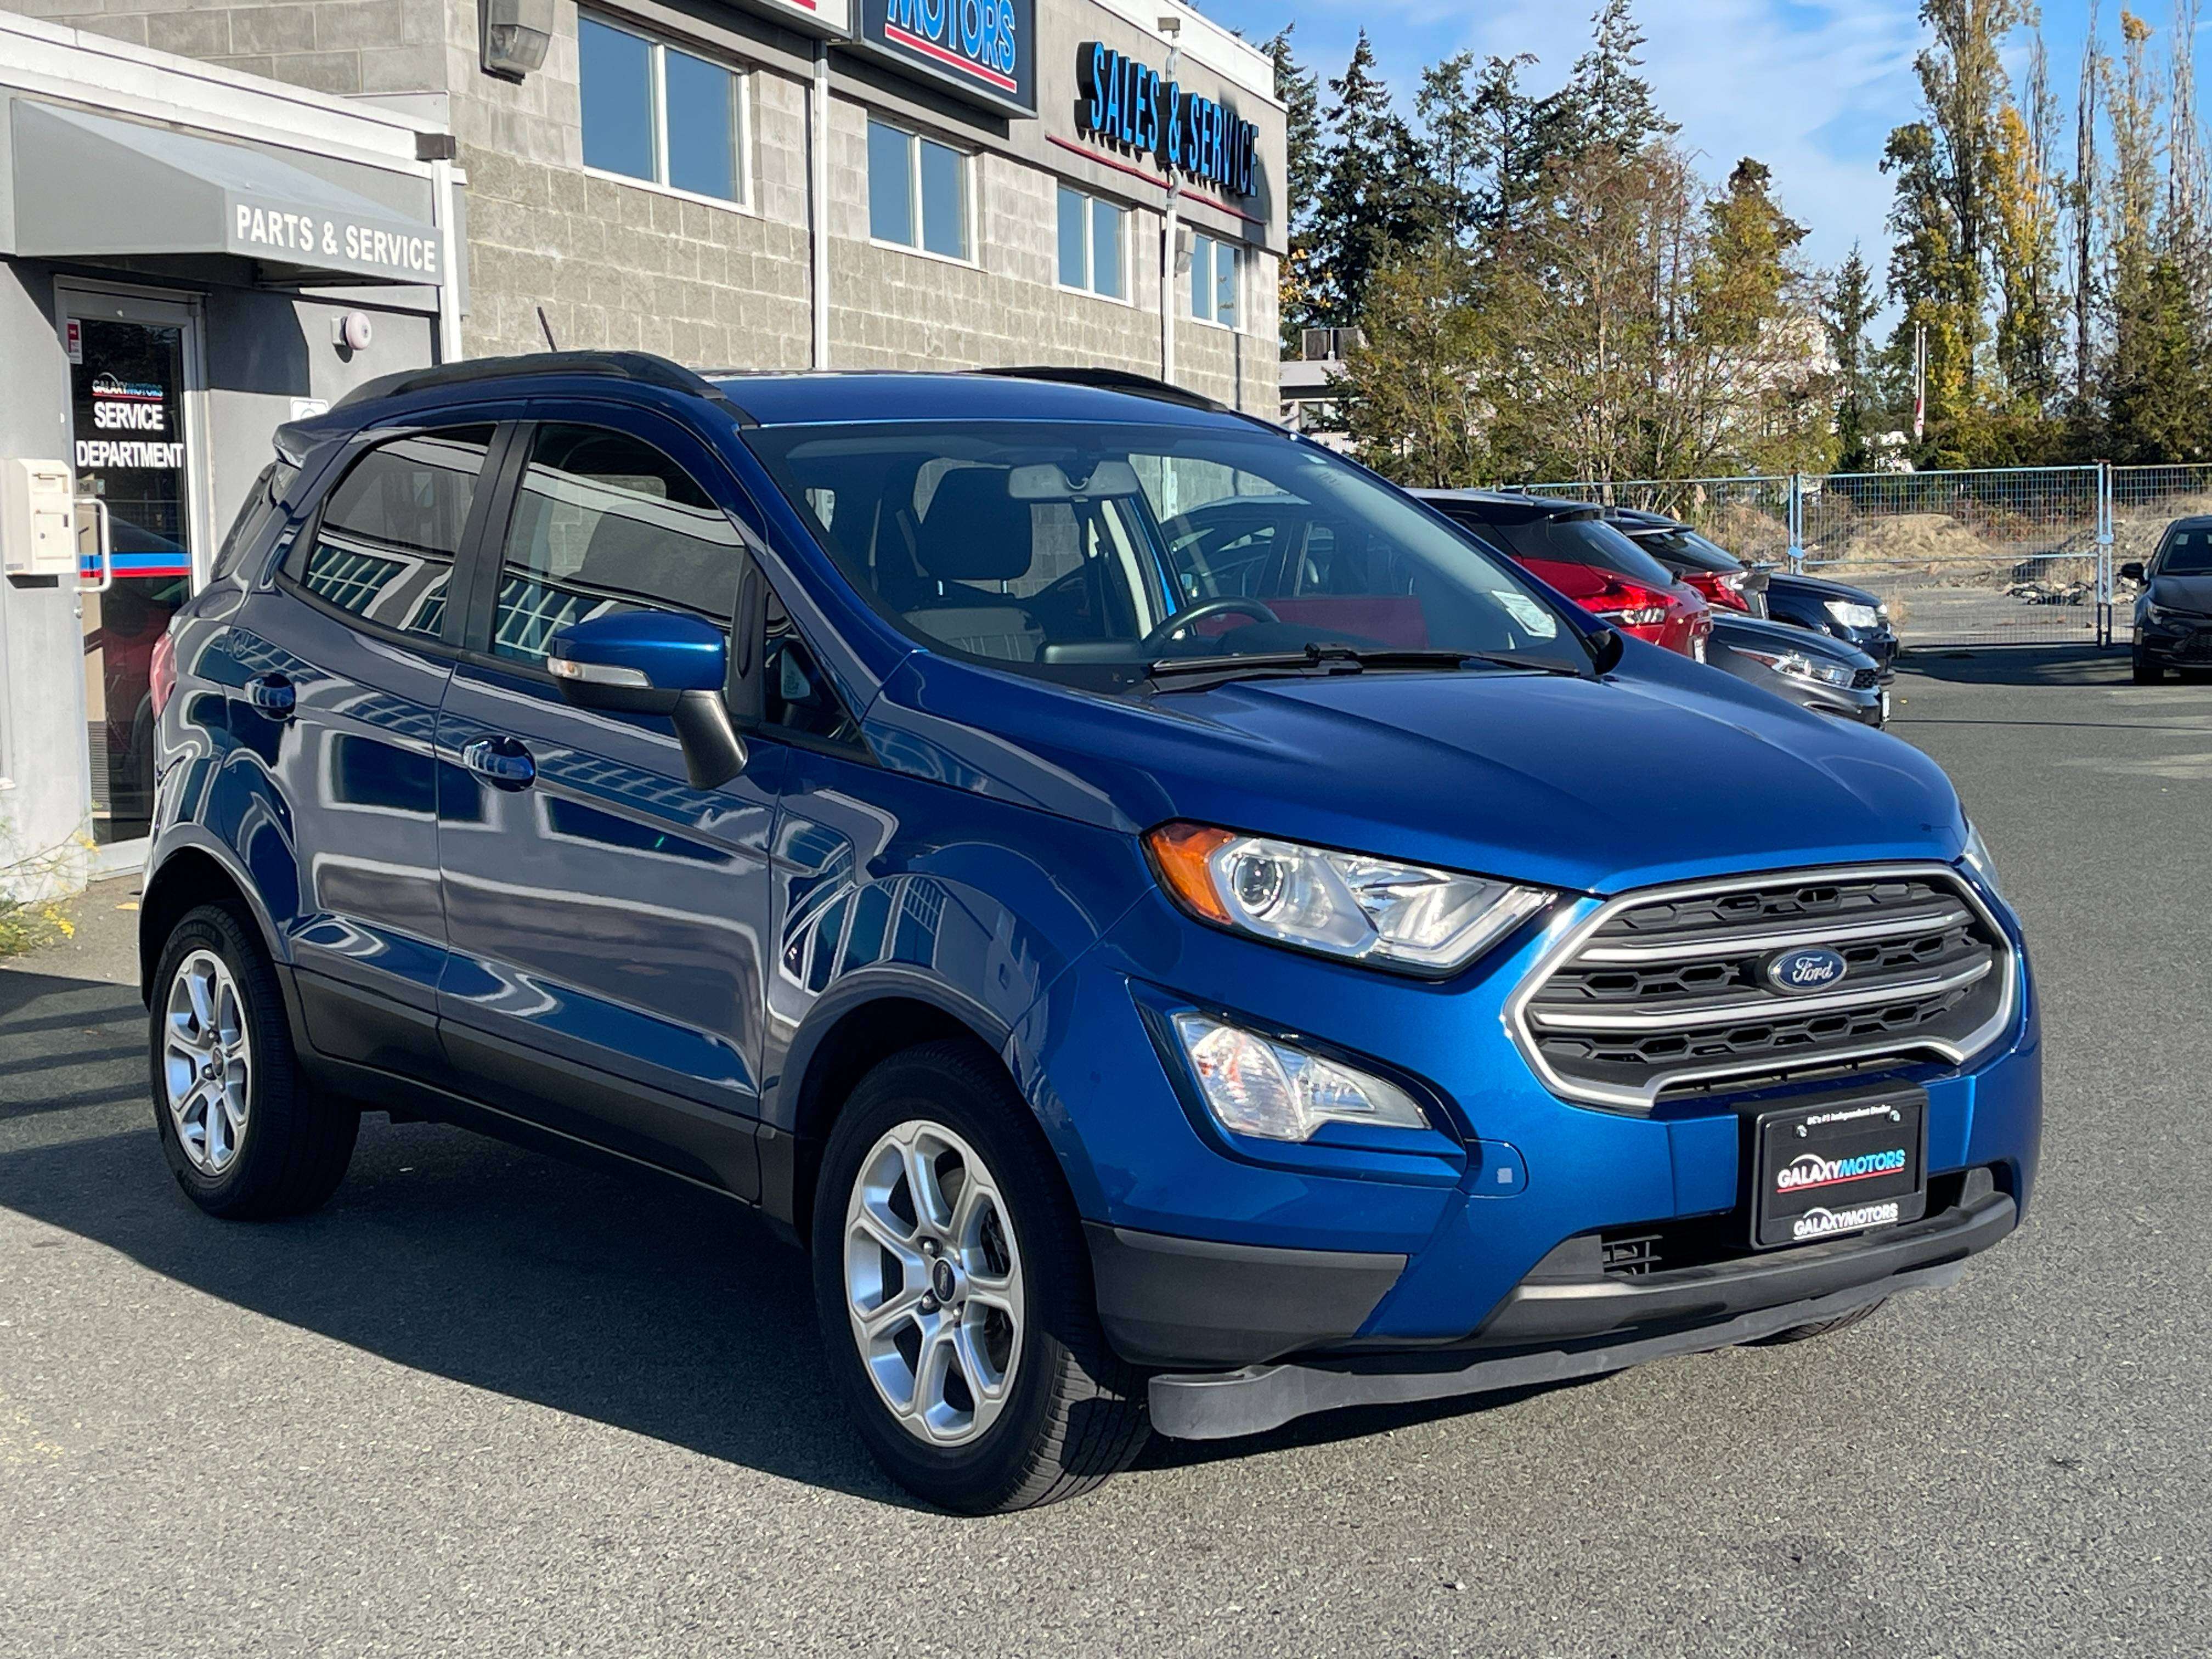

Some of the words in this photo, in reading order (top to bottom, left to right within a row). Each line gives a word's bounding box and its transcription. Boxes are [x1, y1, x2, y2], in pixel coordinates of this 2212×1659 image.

[1088, 41, 1160, 153] SALES
[1188, 92, 1259, 197] SERVICE
[236, 204, 314, 252] PARTS
[322, 221, 338, 256] &
[345, 225, 436, 273] SERVICE
[94, 402, 164, 430] SERVICE
[76, 440, 184, 468] DEPARTMENT
[1792, 956, 1833, 983] Ford
